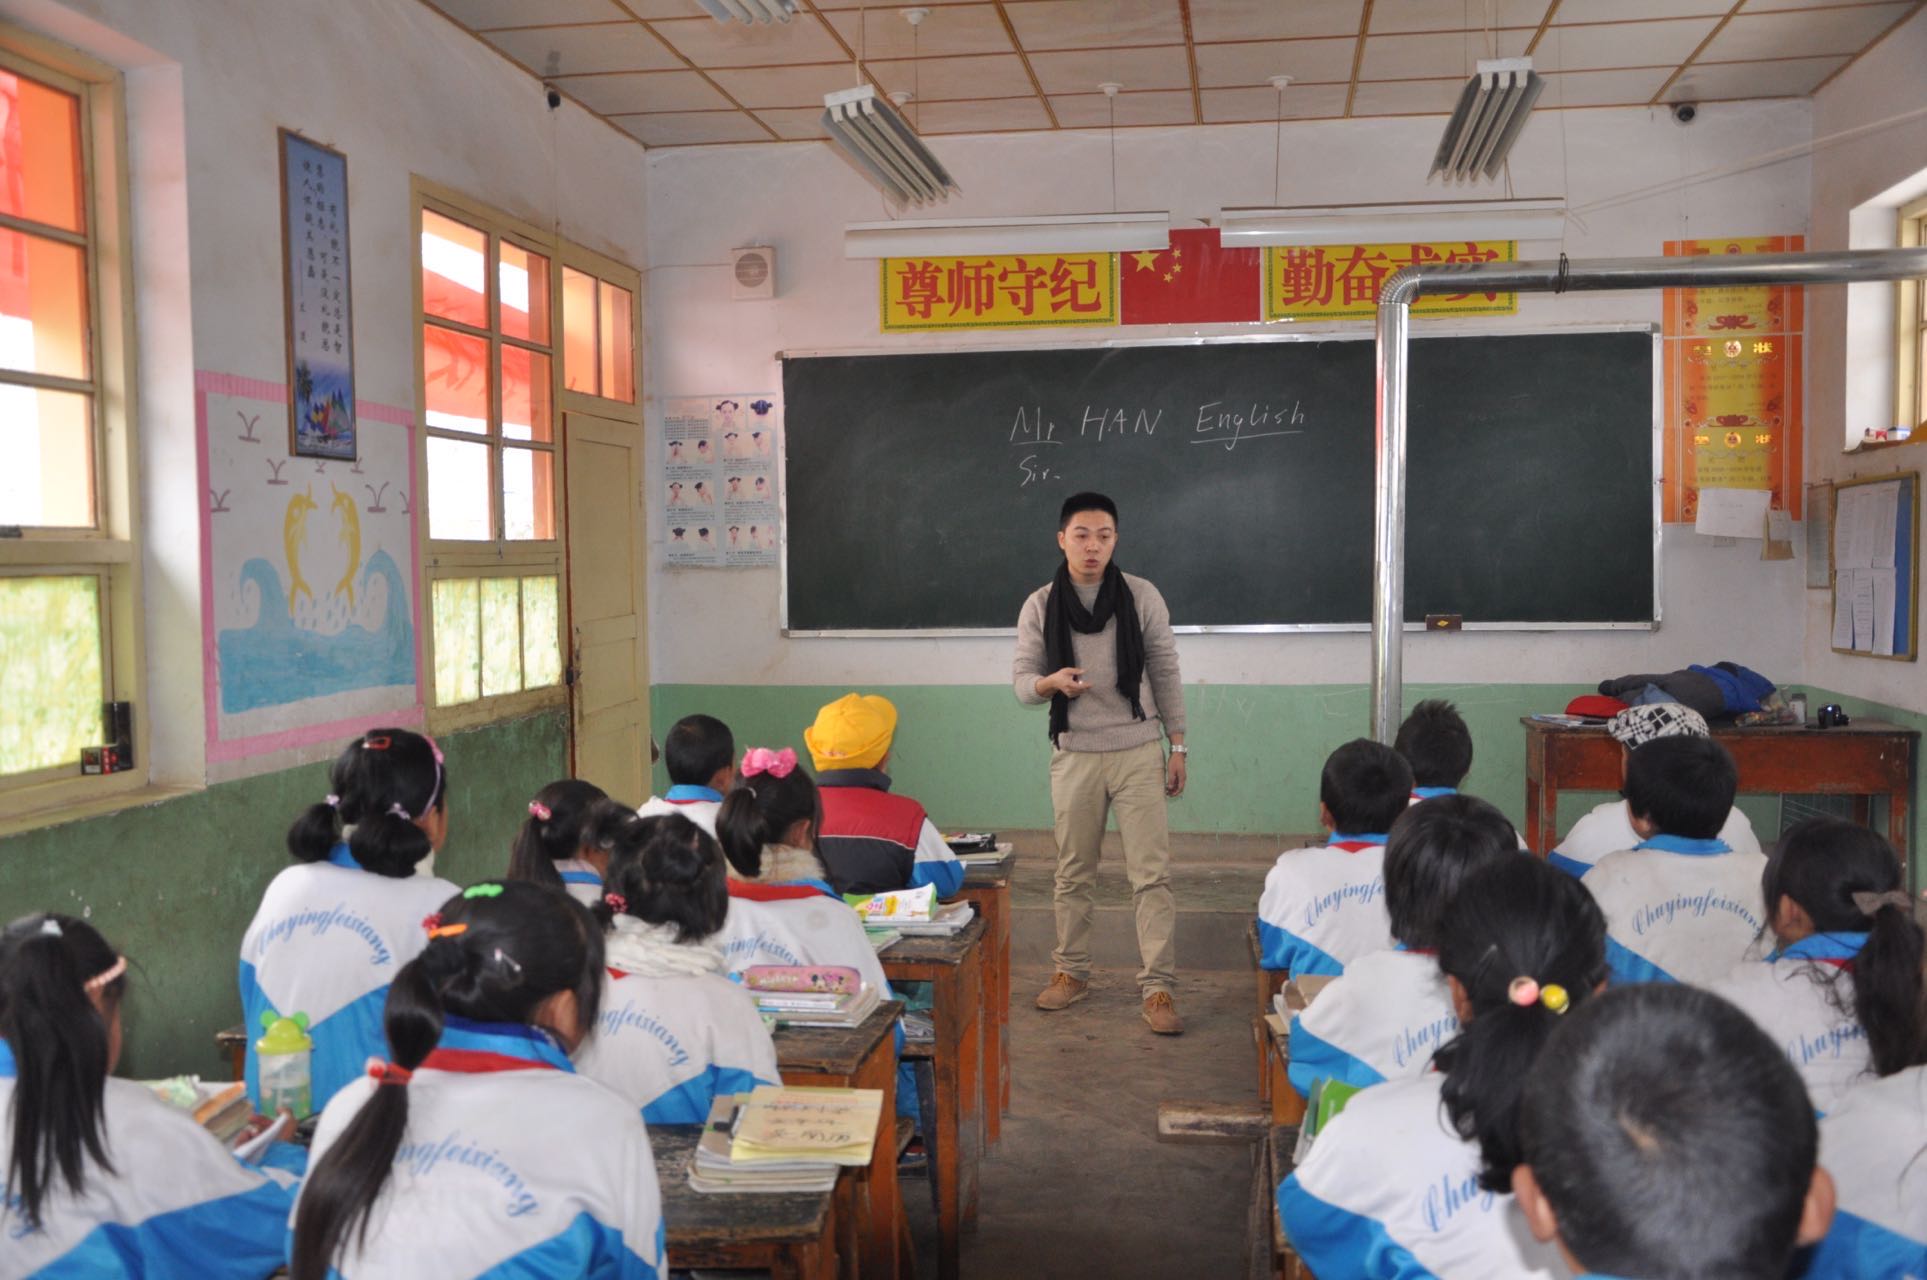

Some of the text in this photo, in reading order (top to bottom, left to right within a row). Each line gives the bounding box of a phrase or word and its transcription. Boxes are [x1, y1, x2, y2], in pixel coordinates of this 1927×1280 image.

[895, 257, 1102, 319] 尊师守纪
[1010, 400, 1305, 451] Mr HAN English
